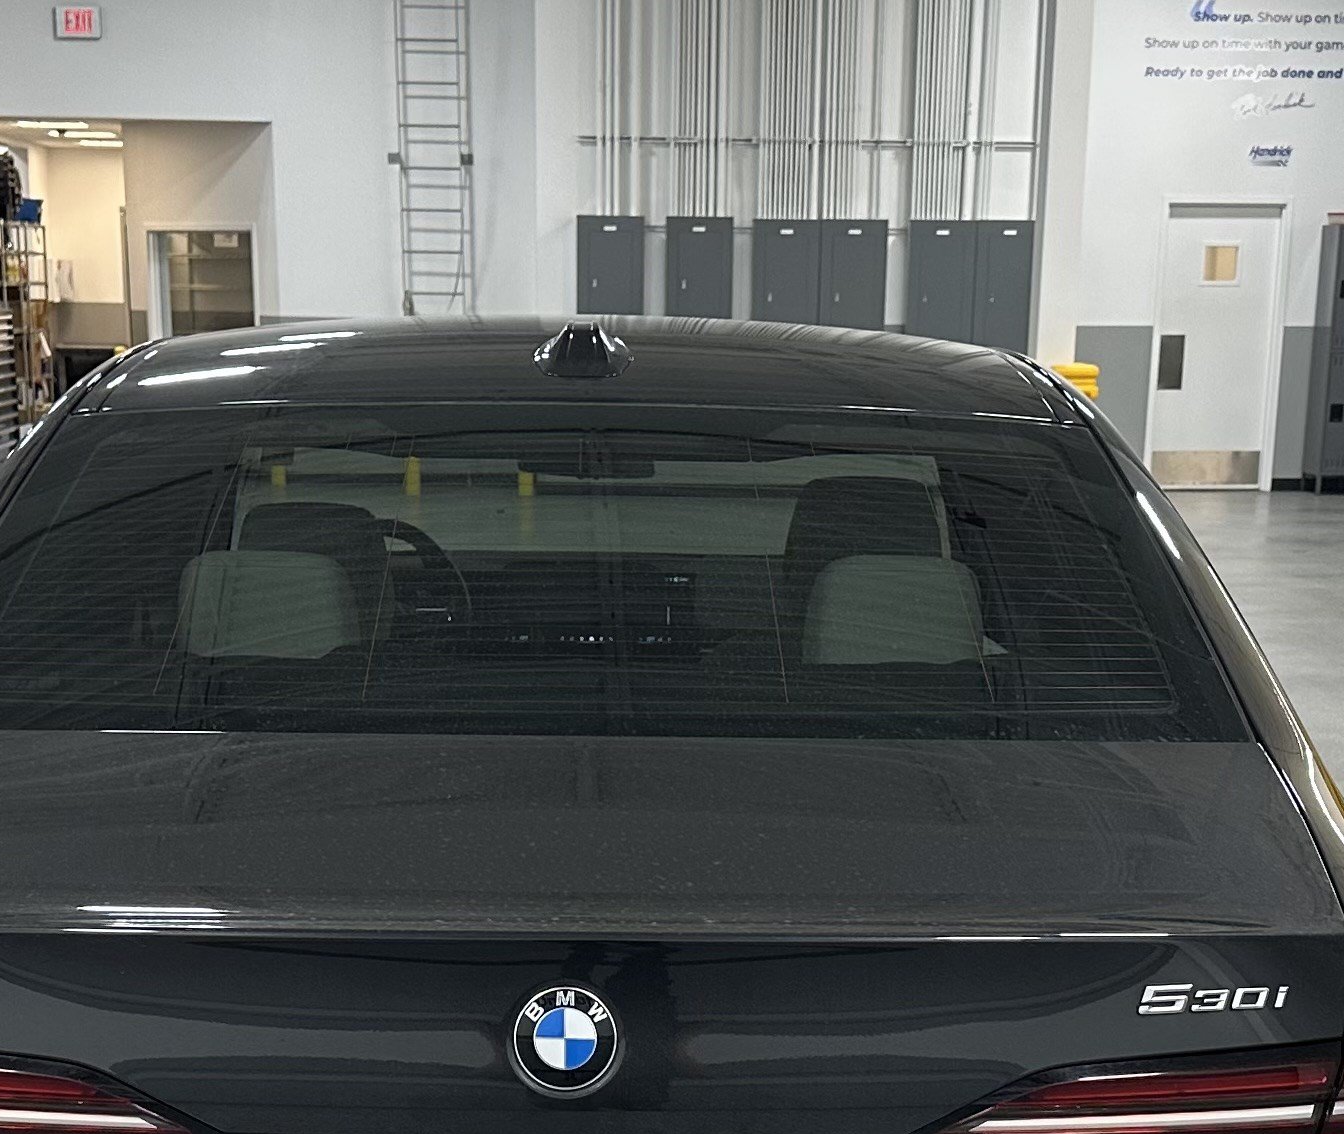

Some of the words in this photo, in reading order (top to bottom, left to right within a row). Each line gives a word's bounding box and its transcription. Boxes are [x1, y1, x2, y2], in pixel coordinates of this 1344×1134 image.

[64, 9, 92, 33] EXIT
[1193, 10, 1230, 23] Show
[1233, 12, 1253, 24] up.
[1257, 11, 1292, 23] Show
[1295, 13, 1313, 26] up
[1315, 14, 1331, 24] on
[1144, 37, 1181, 48] Show
[1183, 39, 1199, 50] up
[1202, 40, 1219, 49] on
[1222, 38, 1251, 49] time
[1253, 39, 1282, 49] with
[1284, 40, 1312, 52] your
[1144, 66, 1186, 79] Ready
[1190, 67, 1203, 77] to
[1206, 67, 1229, 80] get
[1232, 67, 1253, 78] the
[1255, 67, 1278, 79] job
[1281, 67, 1314, 79] done
[1317, 68, 1344, 79] and
[524, 990, 608, 1023] BMW
[1138, 983, 1290, 1015] 530i
